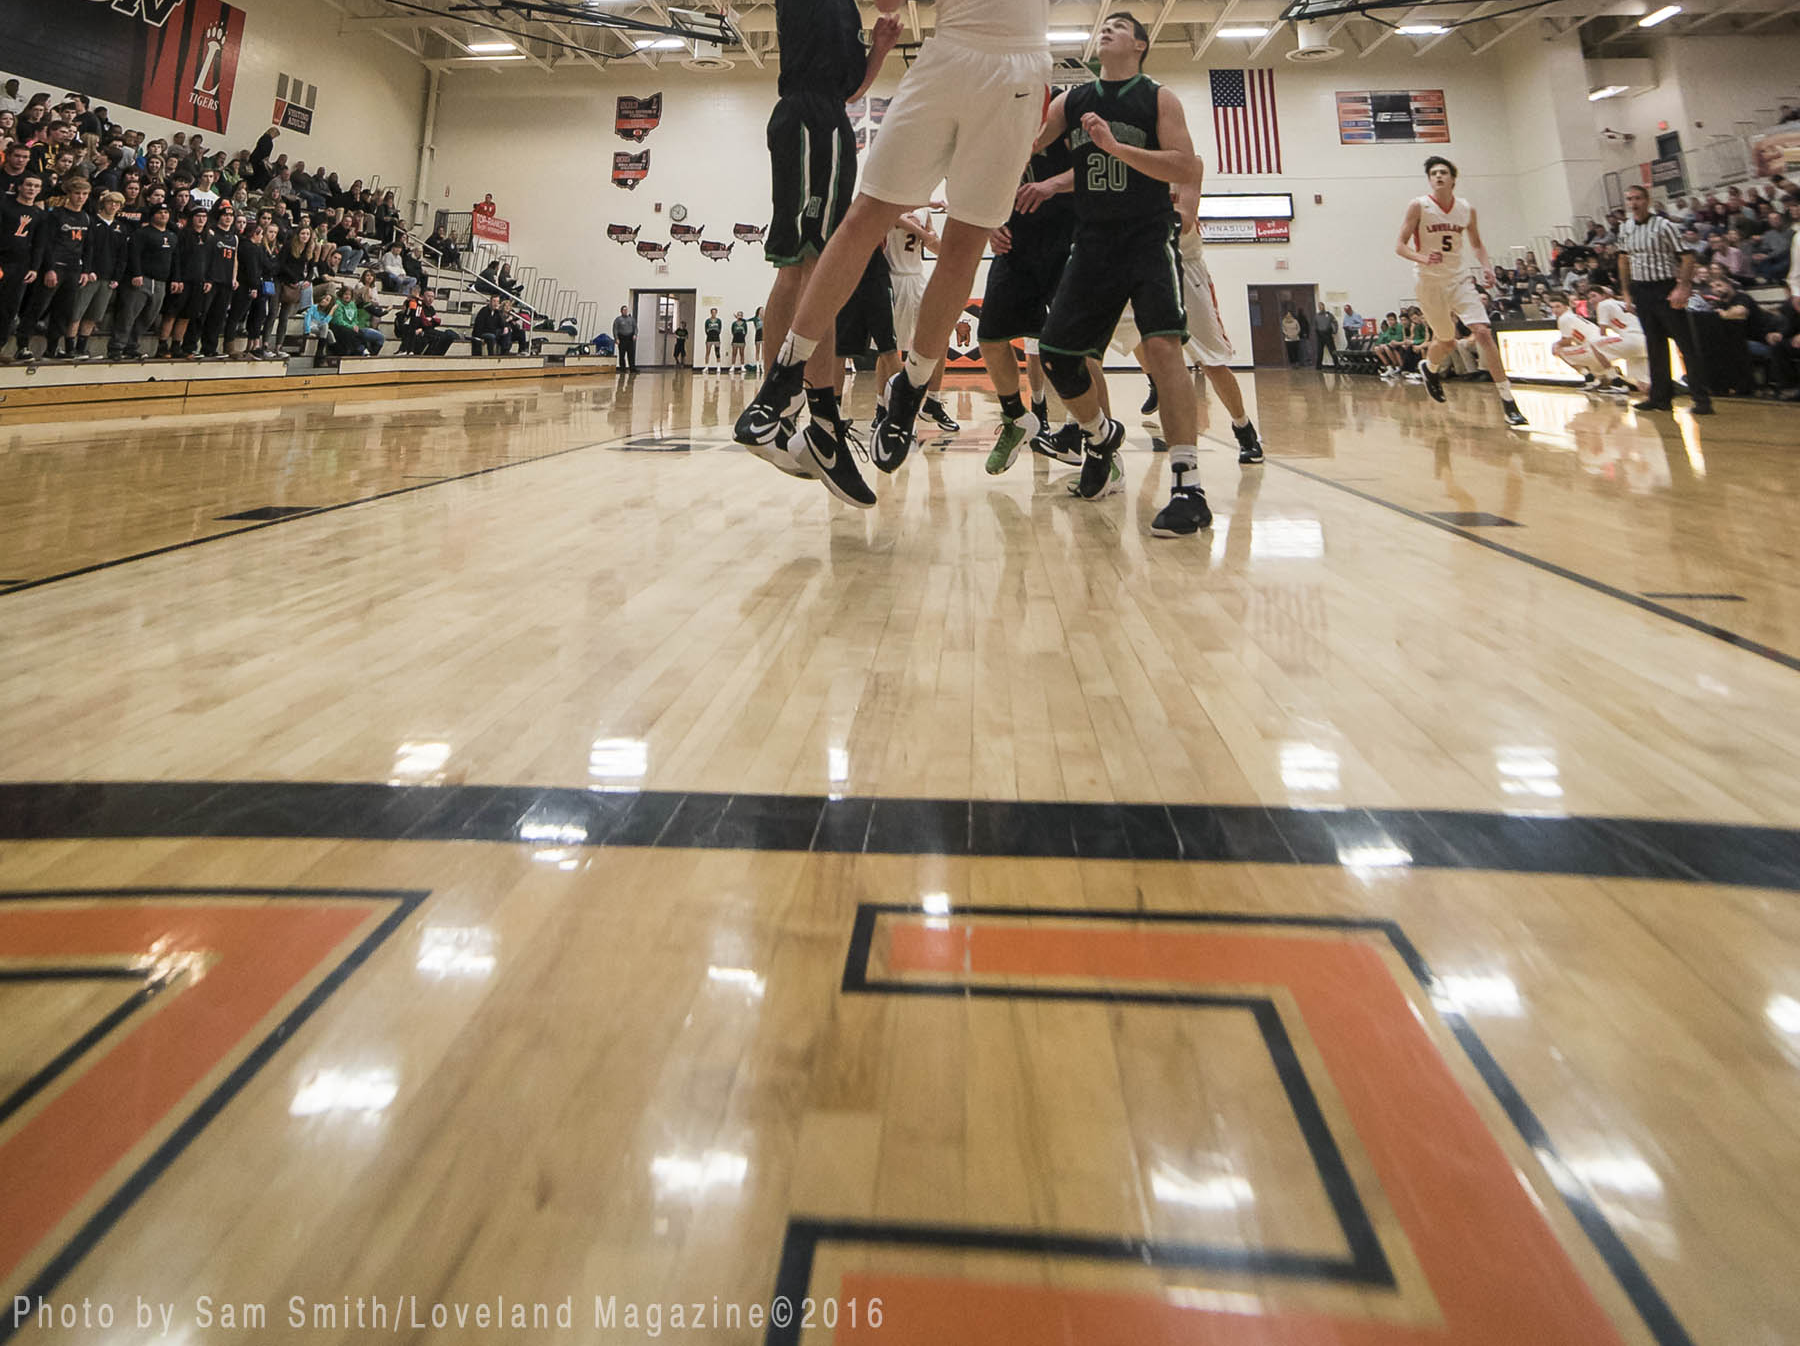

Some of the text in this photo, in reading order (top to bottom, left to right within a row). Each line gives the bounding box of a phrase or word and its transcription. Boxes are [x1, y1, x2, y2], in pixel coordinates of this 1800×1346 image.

[188, 92, 220, 111] TIGERS
[1087, 153, 1127, 191] 20
[904, 233, 917, 252] 2
[1442, 235, 1453, 252] 5
[223, 249, 233, 259] 13
